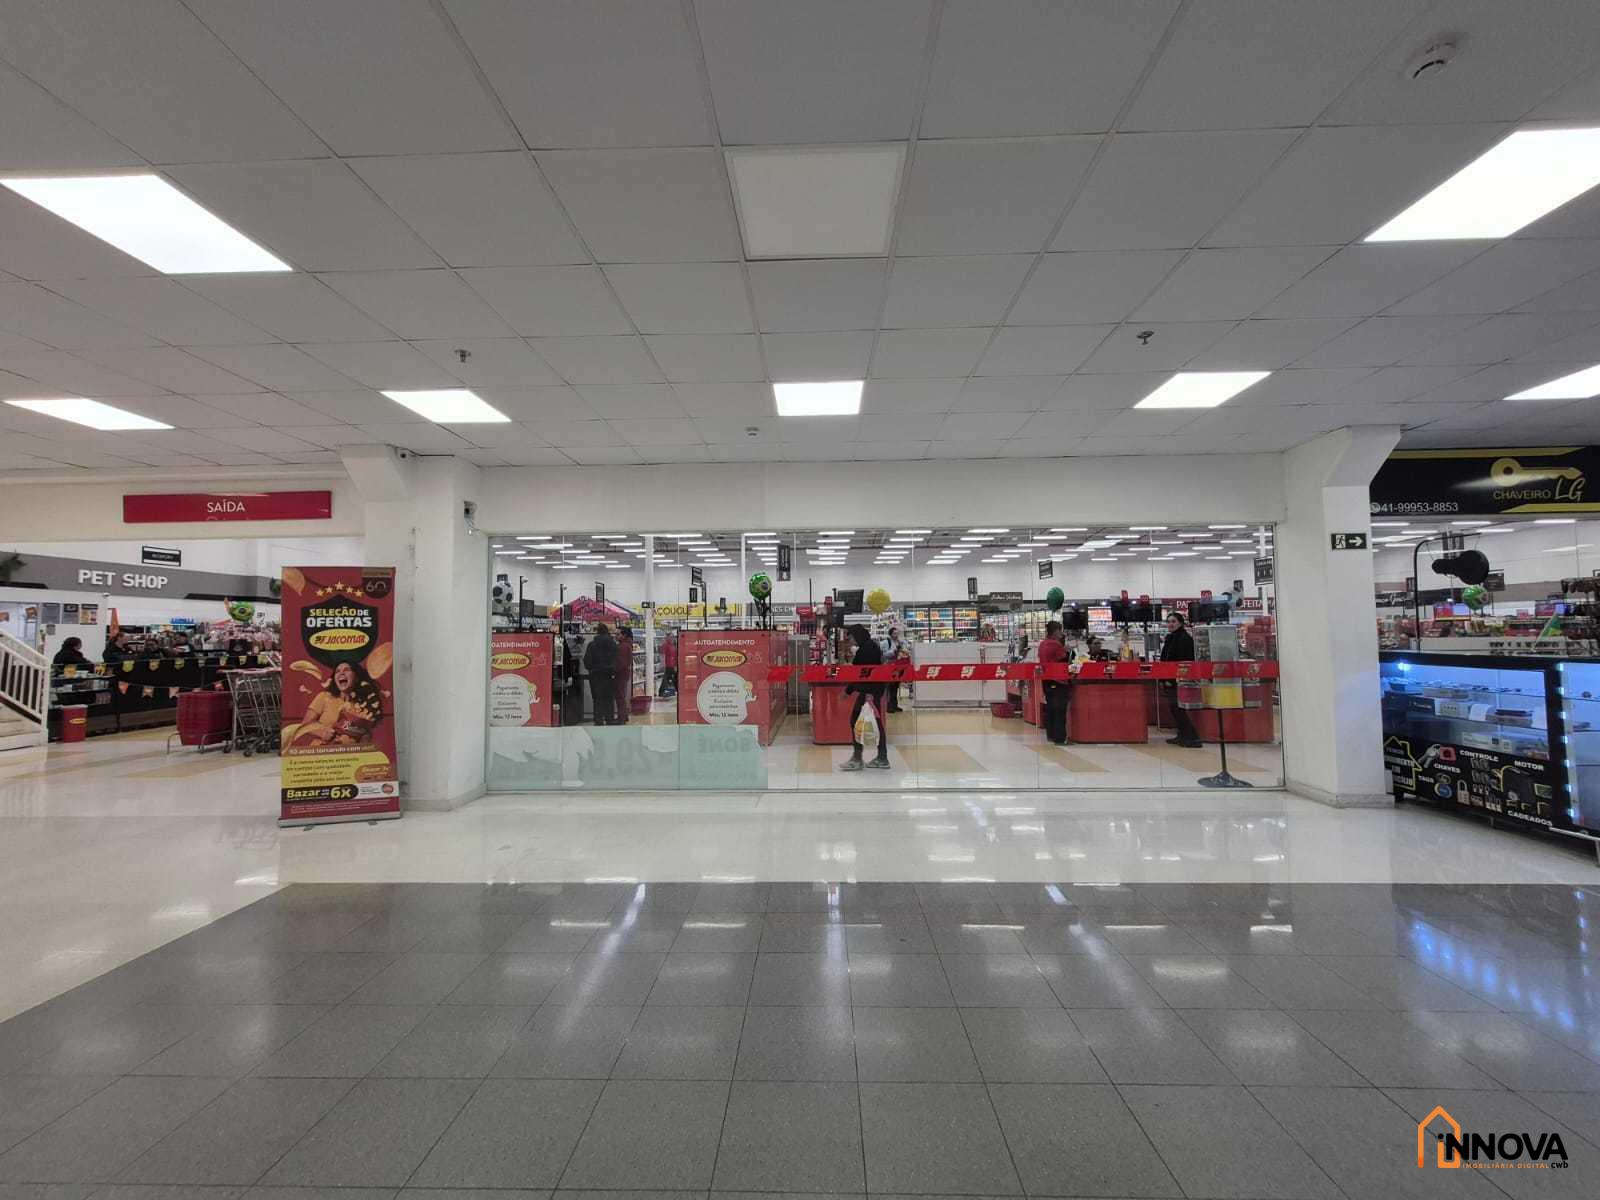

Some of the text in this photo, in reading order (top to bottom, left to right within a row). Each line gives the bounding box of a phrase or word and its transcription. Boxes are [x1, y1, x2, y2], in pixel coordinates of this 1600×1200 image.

[1492, 489, 1551, 500] CHAVEIRO
[1555, 477, 1586, 502] LG
[206, 499, 246, 513] SAÍDA
[1379, 502, 1459, 513] 41-99953-8853
[77, 569, 169, 589] PET SHOP
[309, 606, 357, 618] SELEÇÃO
[306, 617, 373, 628] OFERTAS
[1460, 750, 1499, 762] CONTROLE
[1434, 763, 1461, 774] CHAVES
[1514, 760, 1544, 771] MOTOR
[1418, 775, 1435, 784] TAGS
[287, 790, 321, 798] Bazar
[330, 786, 352, 799] 6x
[1507, 810, 1553, 827] CADEADOS
